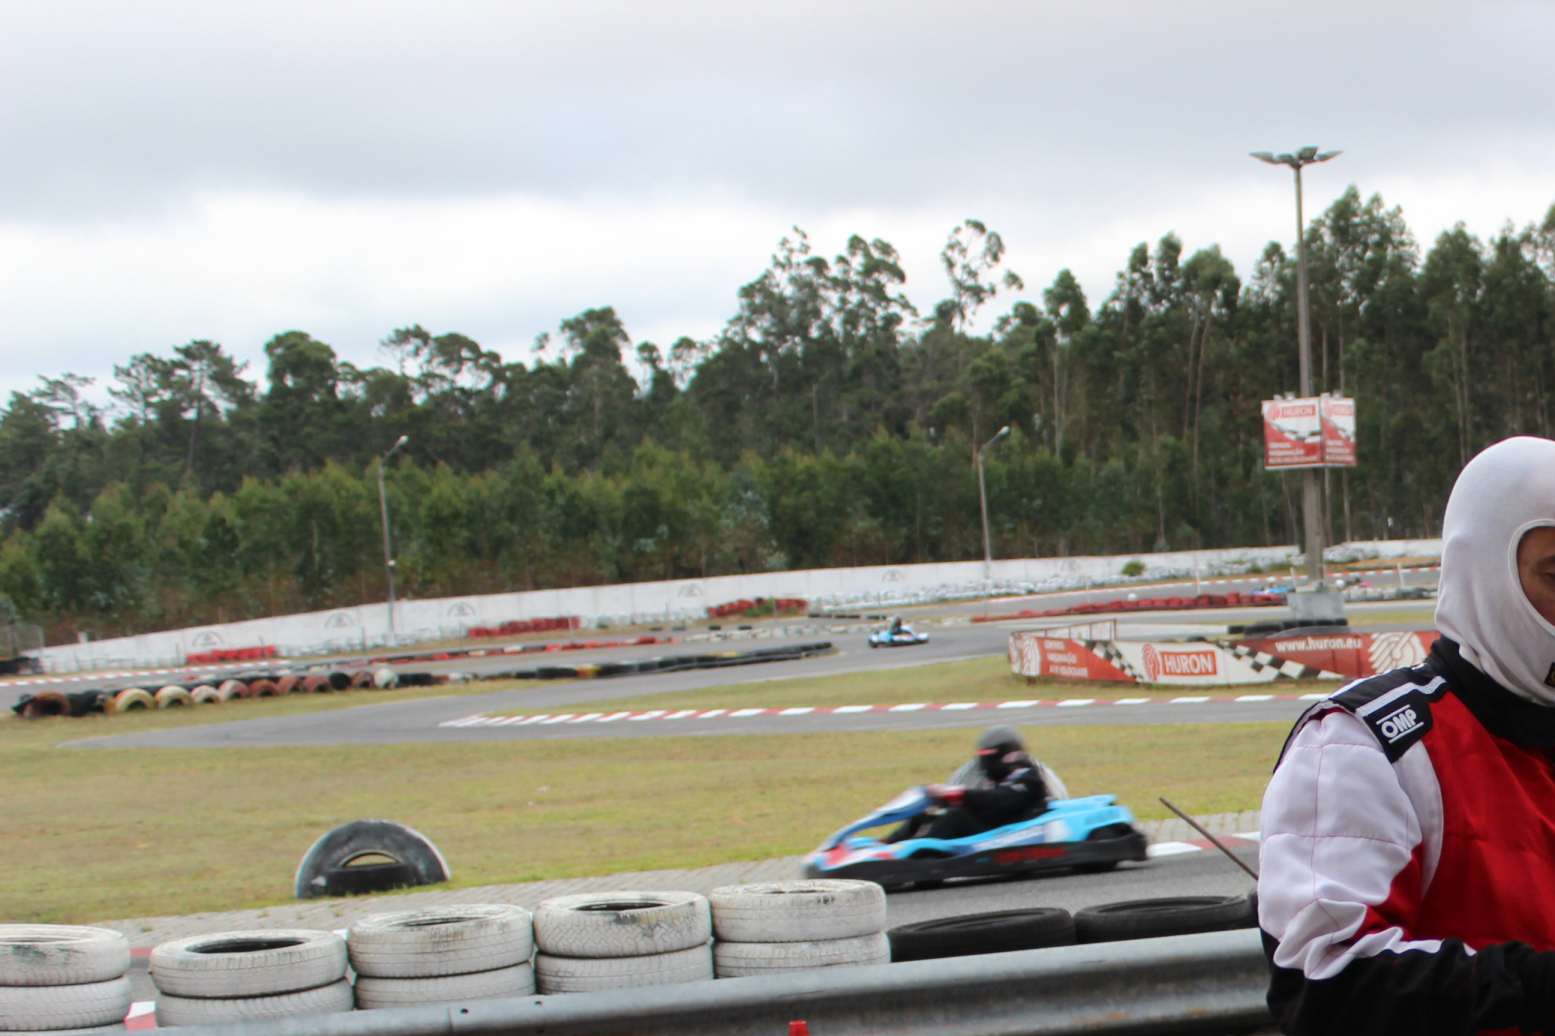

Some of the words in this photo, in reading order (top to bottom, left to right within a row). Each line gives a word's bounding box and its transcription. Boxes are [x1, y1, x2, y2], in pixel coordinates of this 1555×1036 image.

[1275, 637, 1362, 652] www.huron.eu
[1164, 653, 1212, 675] HURON
[1381, 708, 1417, 738] OMP
